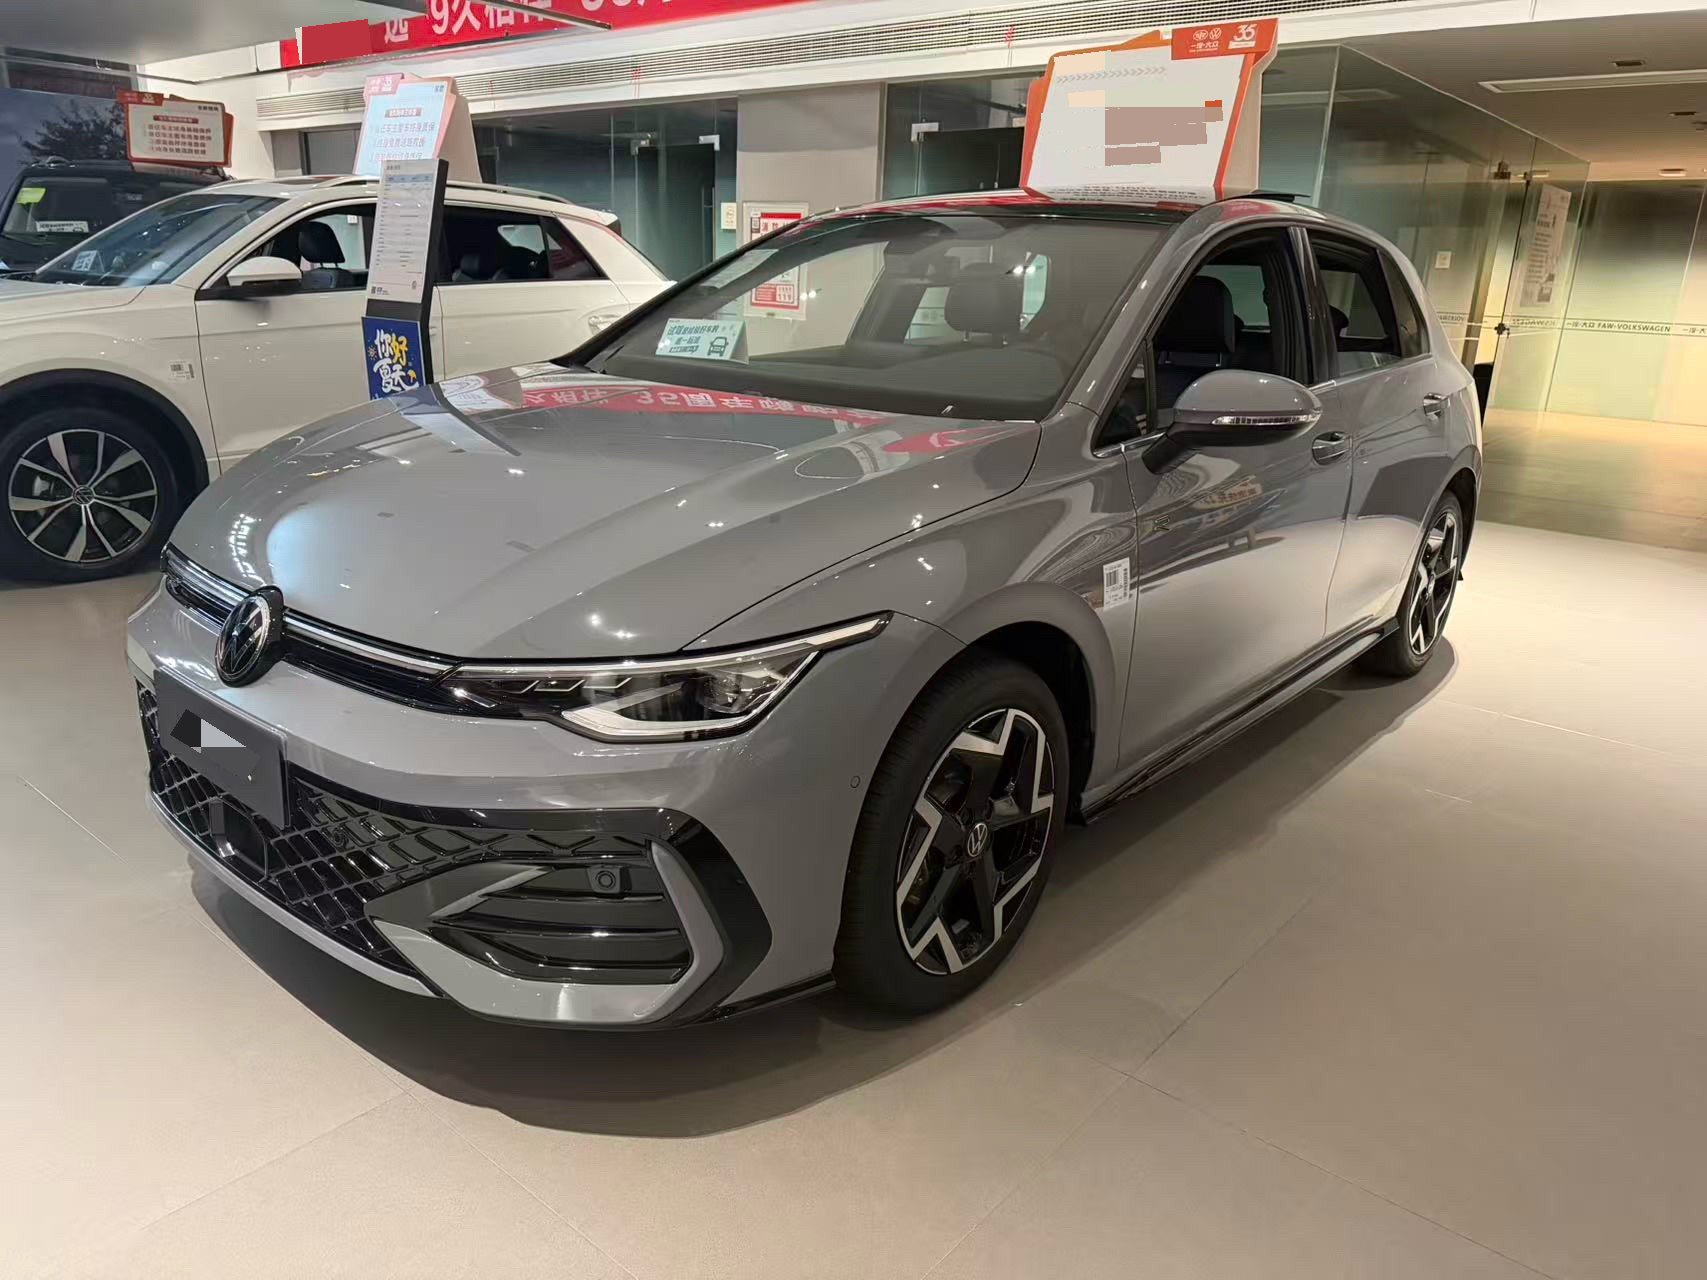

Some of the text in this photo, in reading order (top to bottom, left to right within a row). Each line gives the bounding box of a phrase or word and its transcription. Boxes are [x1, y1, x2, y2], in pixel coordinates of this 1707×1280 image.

[1598, 321, 1671, 333] FAW-VOLKSWAGEN
[374, 328, 409, 366] 你好
[373, 357, 420, 393] 夏天
